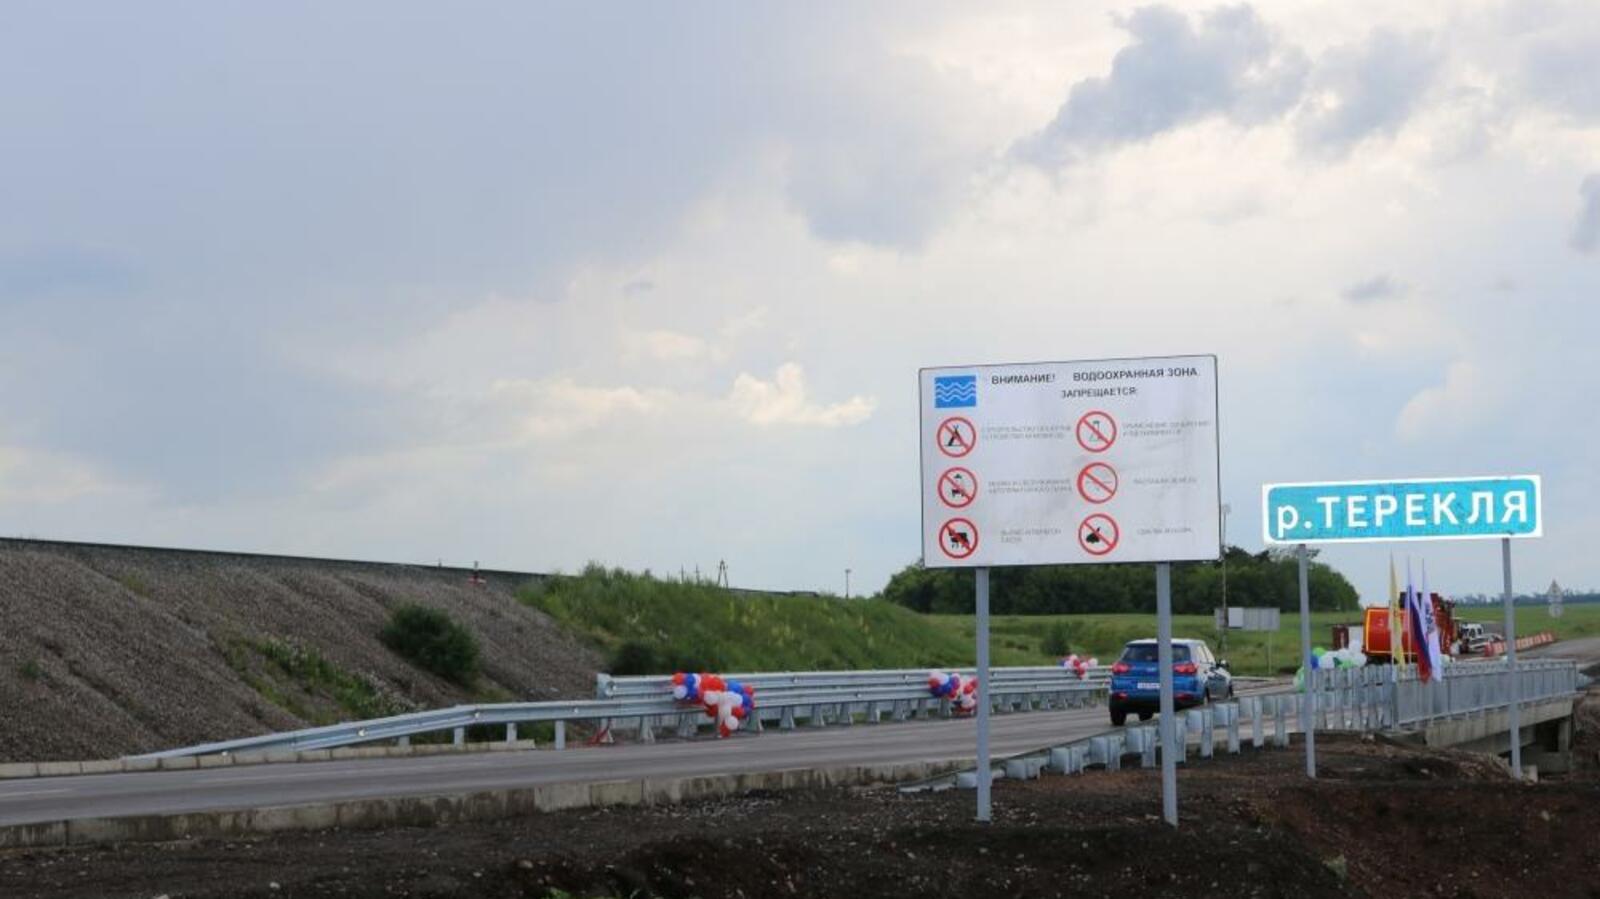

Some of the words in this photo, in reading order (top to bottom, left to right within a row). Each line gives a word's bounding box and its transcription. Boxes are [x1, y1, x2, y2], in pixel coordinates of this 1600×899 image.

[991, 375, 1055, 385] ВНИМАНИЕ!
[1073, 369, 1163, 382] ВОДООХРАННАЯ
[1167, 368, 1198, 377] ЗОНА
